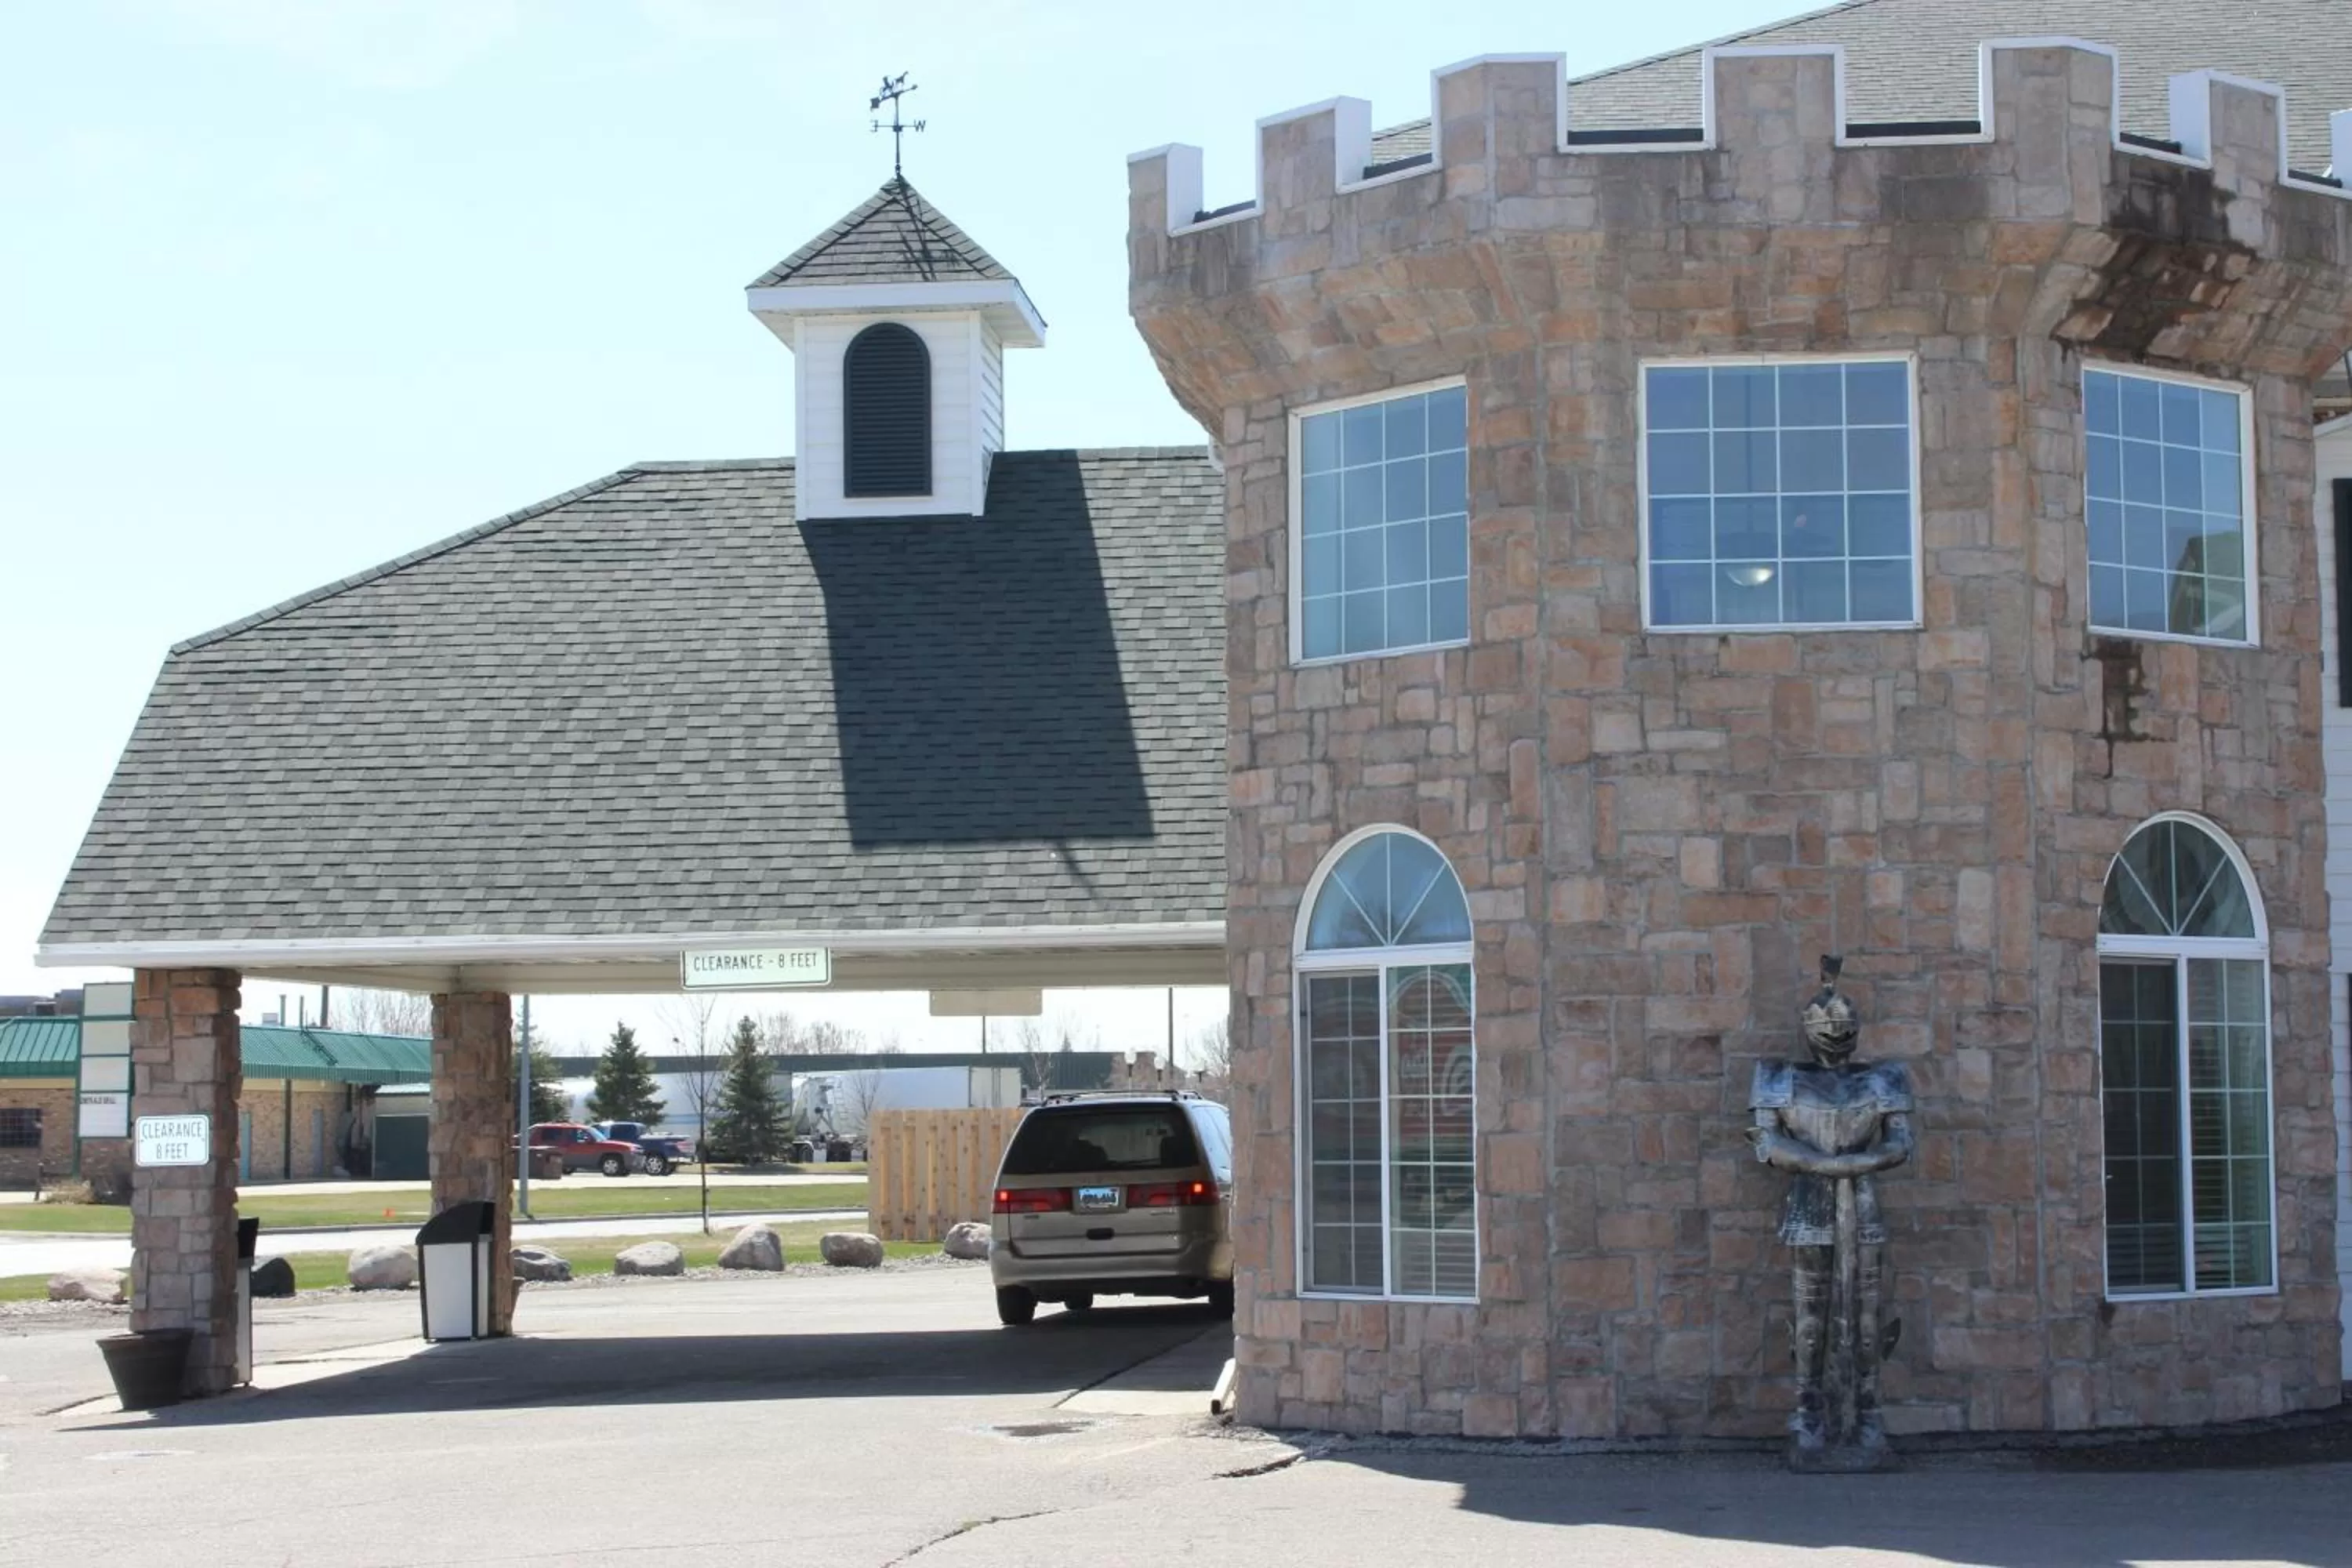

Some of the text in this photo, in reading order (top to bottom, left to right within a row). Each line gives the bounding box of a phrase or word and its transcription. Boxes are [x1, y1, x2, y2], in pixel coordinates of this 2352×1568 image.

[693, 954, 764, 971] CLEARANCE
[779, 953, 786, 968] 8
[790, 953, 817, 967] FEET
[142, 1122, 202, 1139] CLEARANCE
[156, 1142, 189, 1159] 8 FEET
